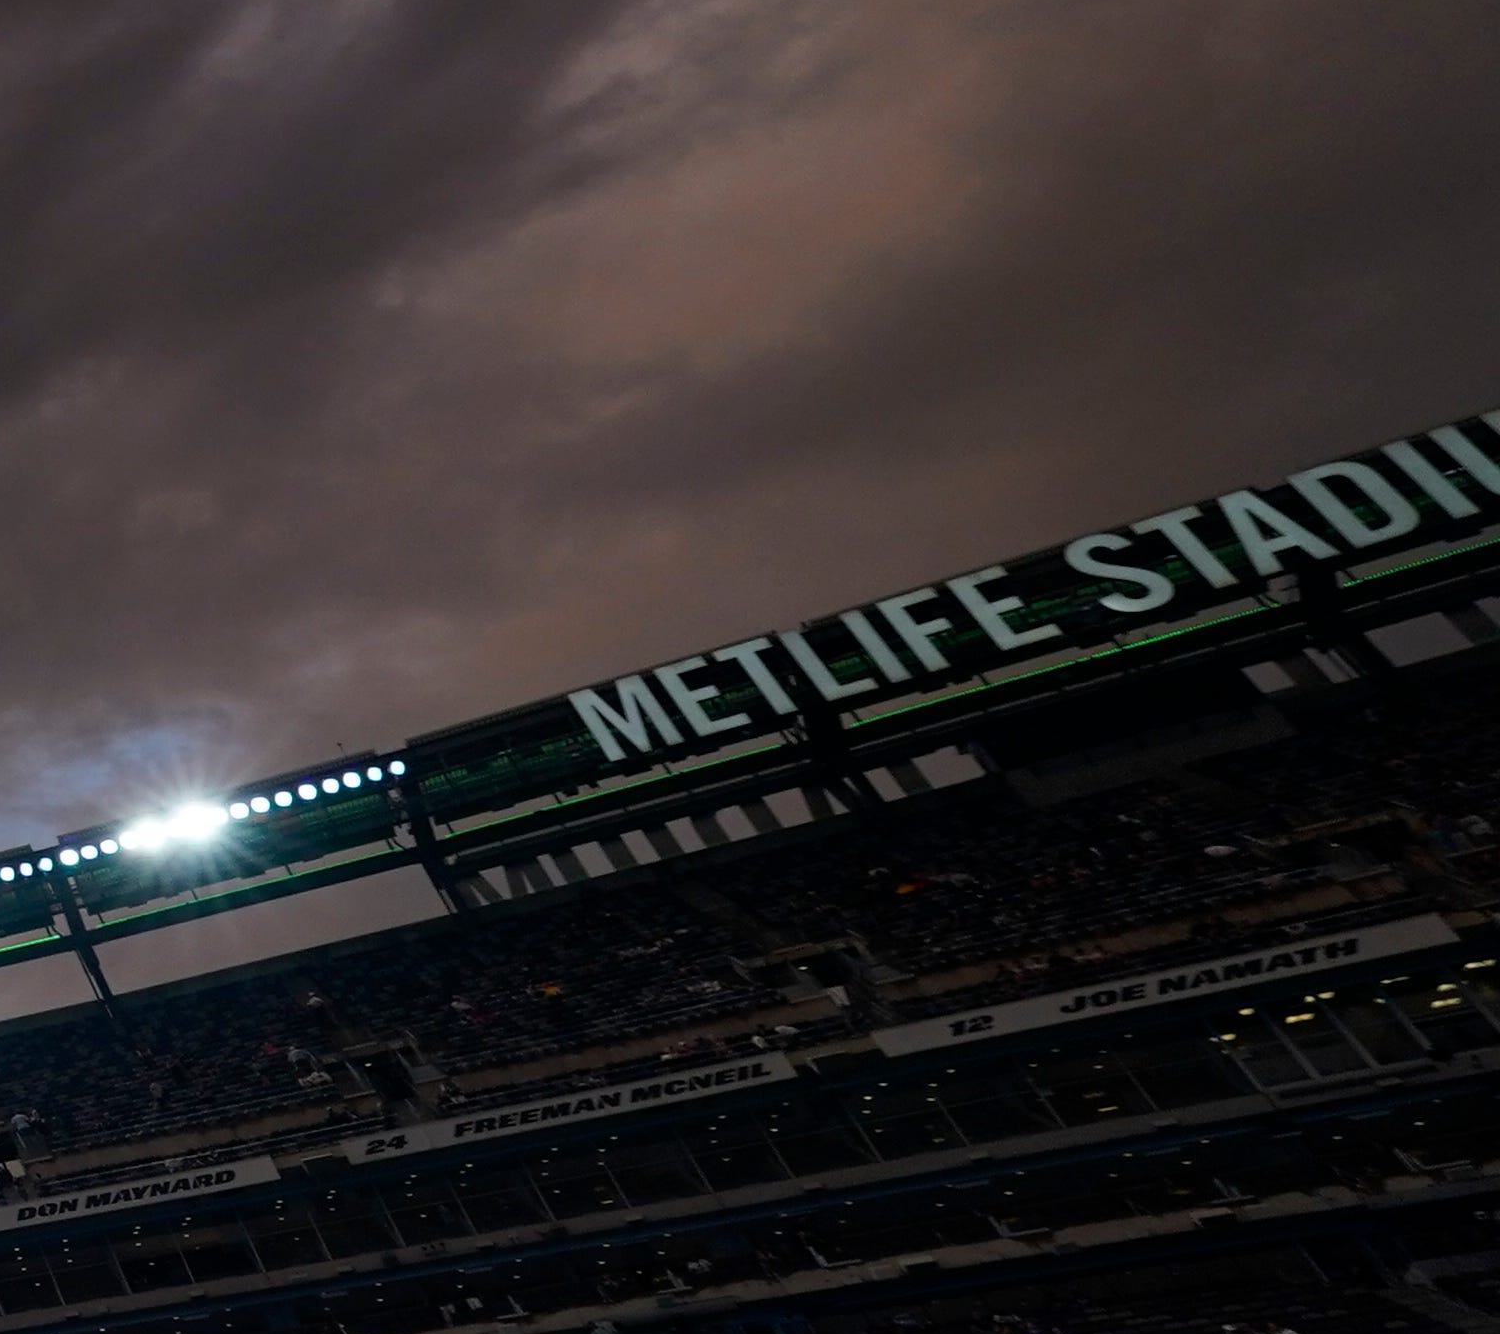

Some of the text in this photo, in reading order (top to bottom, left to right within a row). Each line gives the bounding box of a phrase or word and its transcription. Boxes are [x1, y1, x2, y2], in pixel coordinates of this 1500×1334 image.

[567, 567, 1062, 761] METLIFE
[950, 938, 1359, 1036] 12 JOE NAMATH
[365, 1064, 772, 1155] 24 FREEMAN MCNEIL
[17, 1199, 78, 1221] DON
[85, 1170, 237, 1208] MAYNARD
